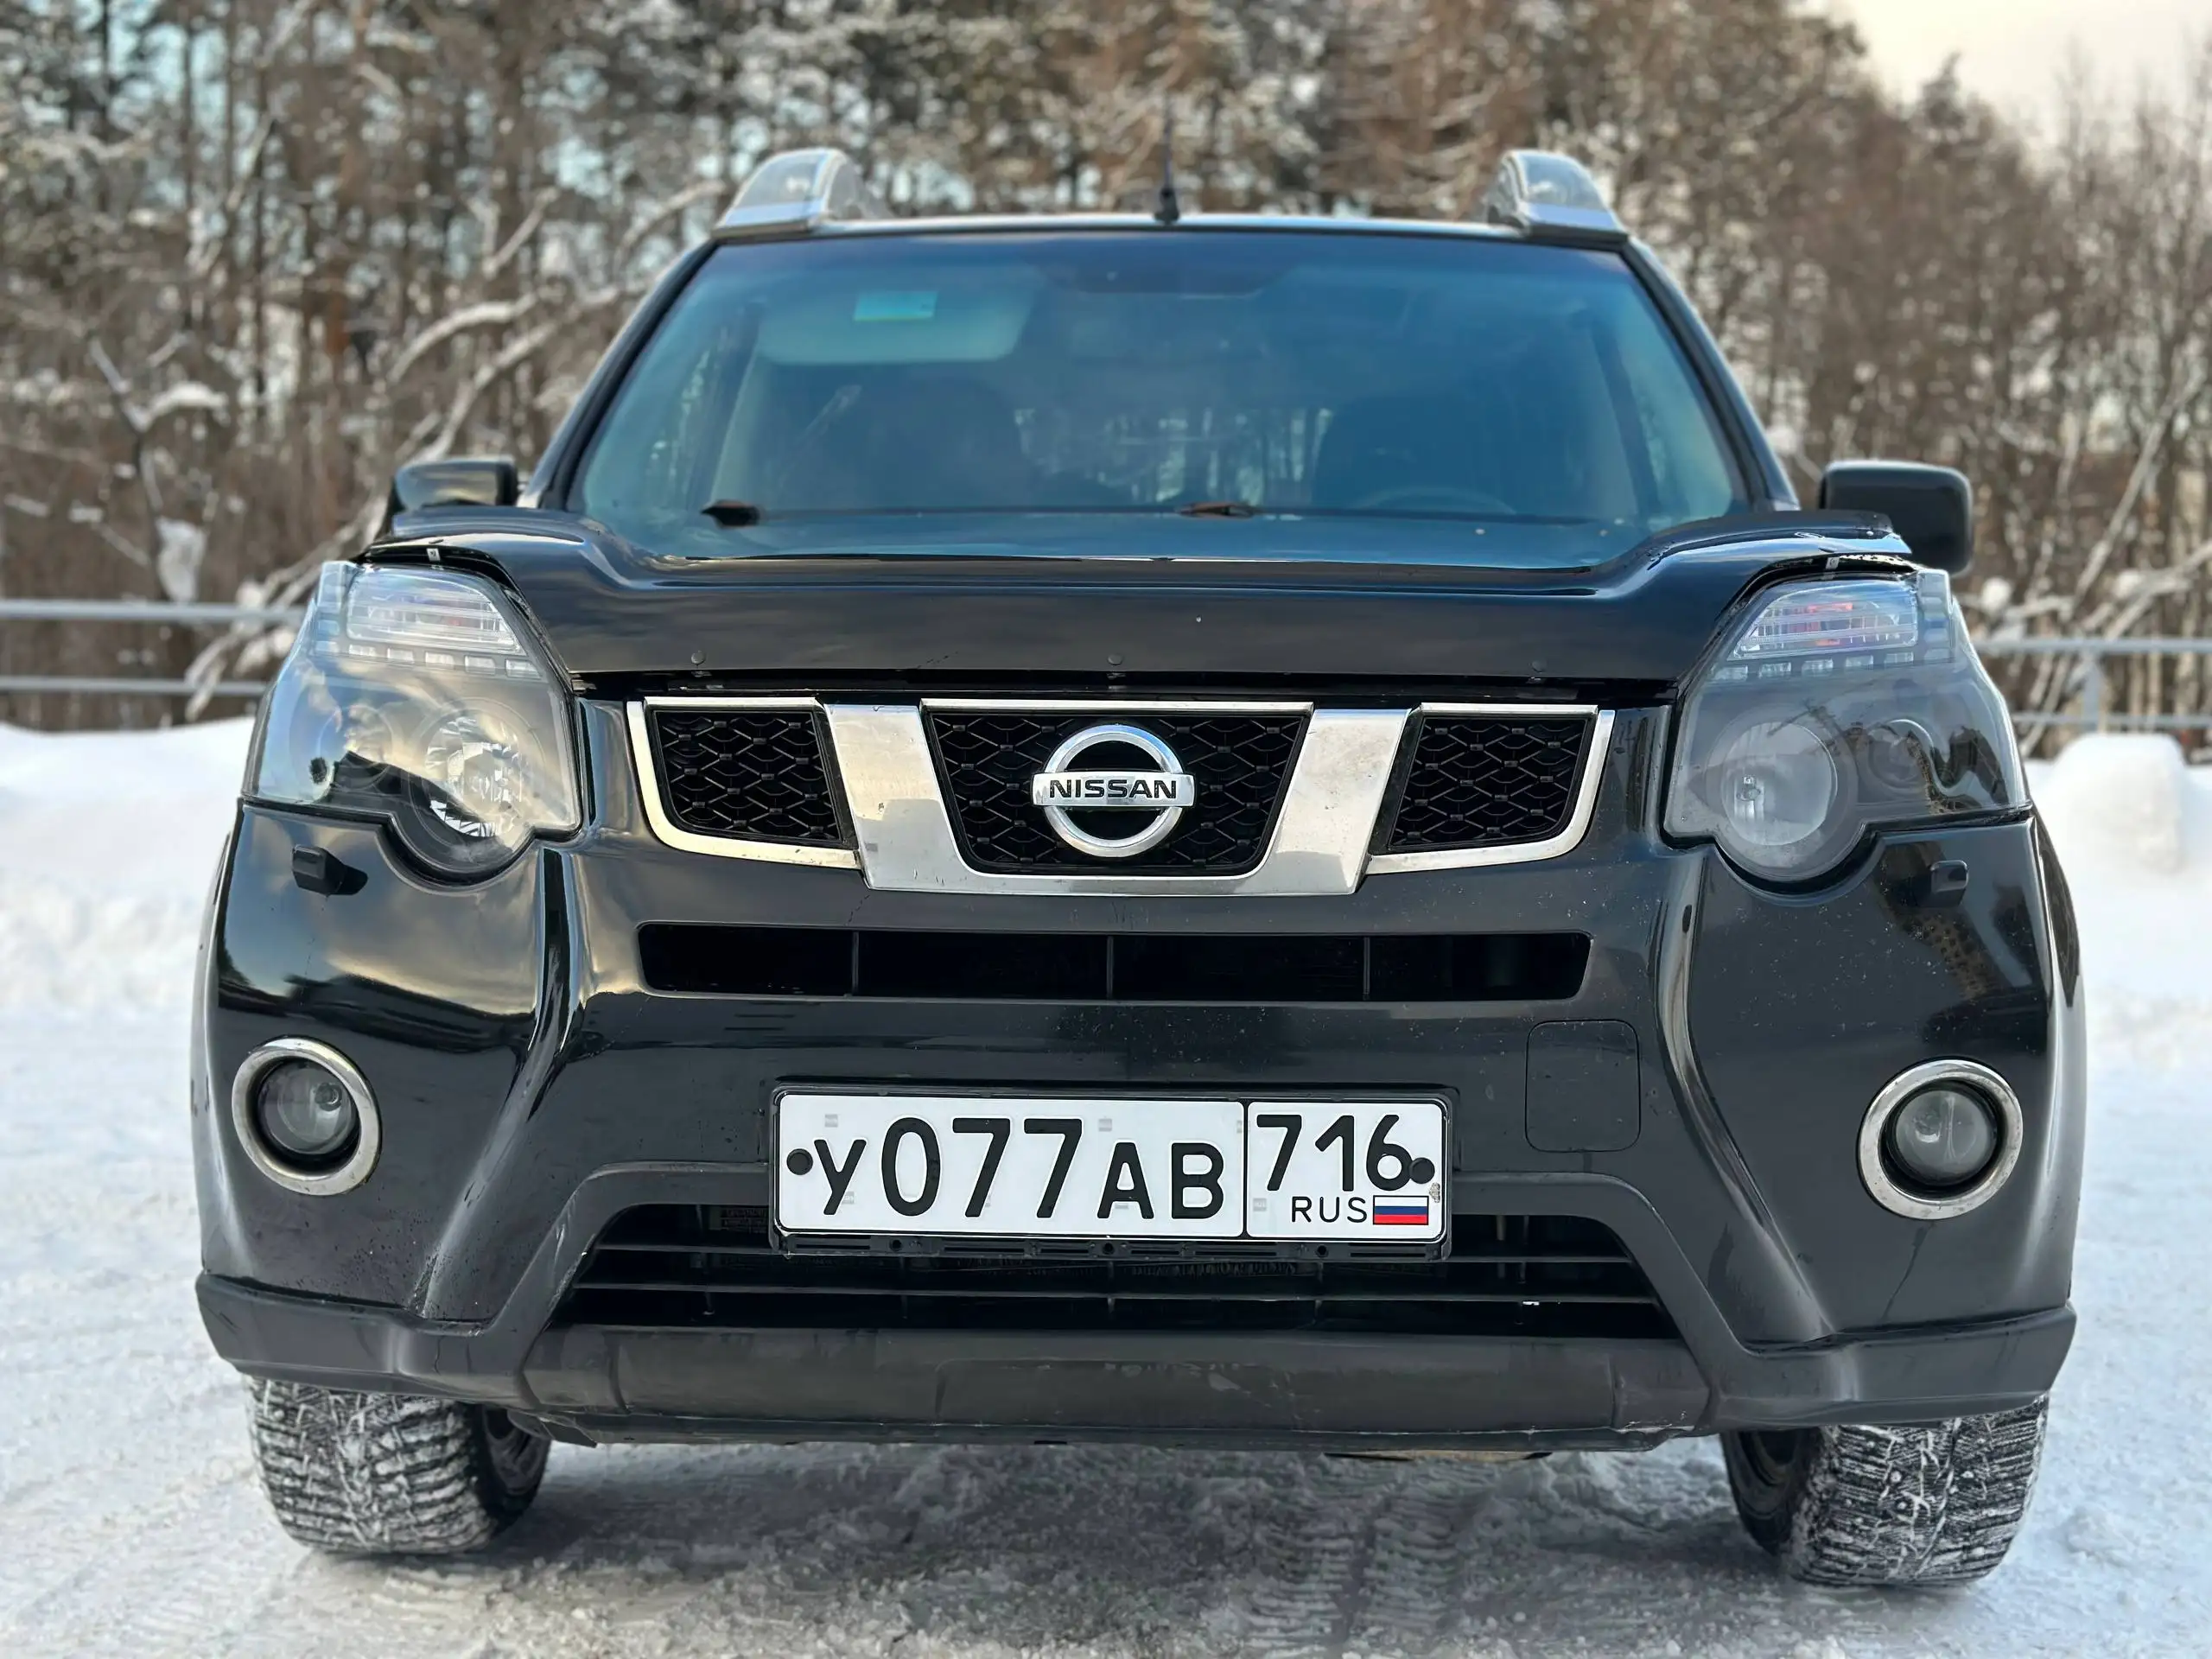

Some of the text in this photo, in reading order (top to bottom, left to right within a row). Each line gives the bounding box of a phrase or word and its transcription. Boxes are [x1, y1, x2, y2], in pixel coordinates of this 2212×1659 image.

[1049, 779, 1177, 799] NISSAN
[1256, 1115, 1414, 1192] 716
[1292, 1197, 1368, 1224] RUS
